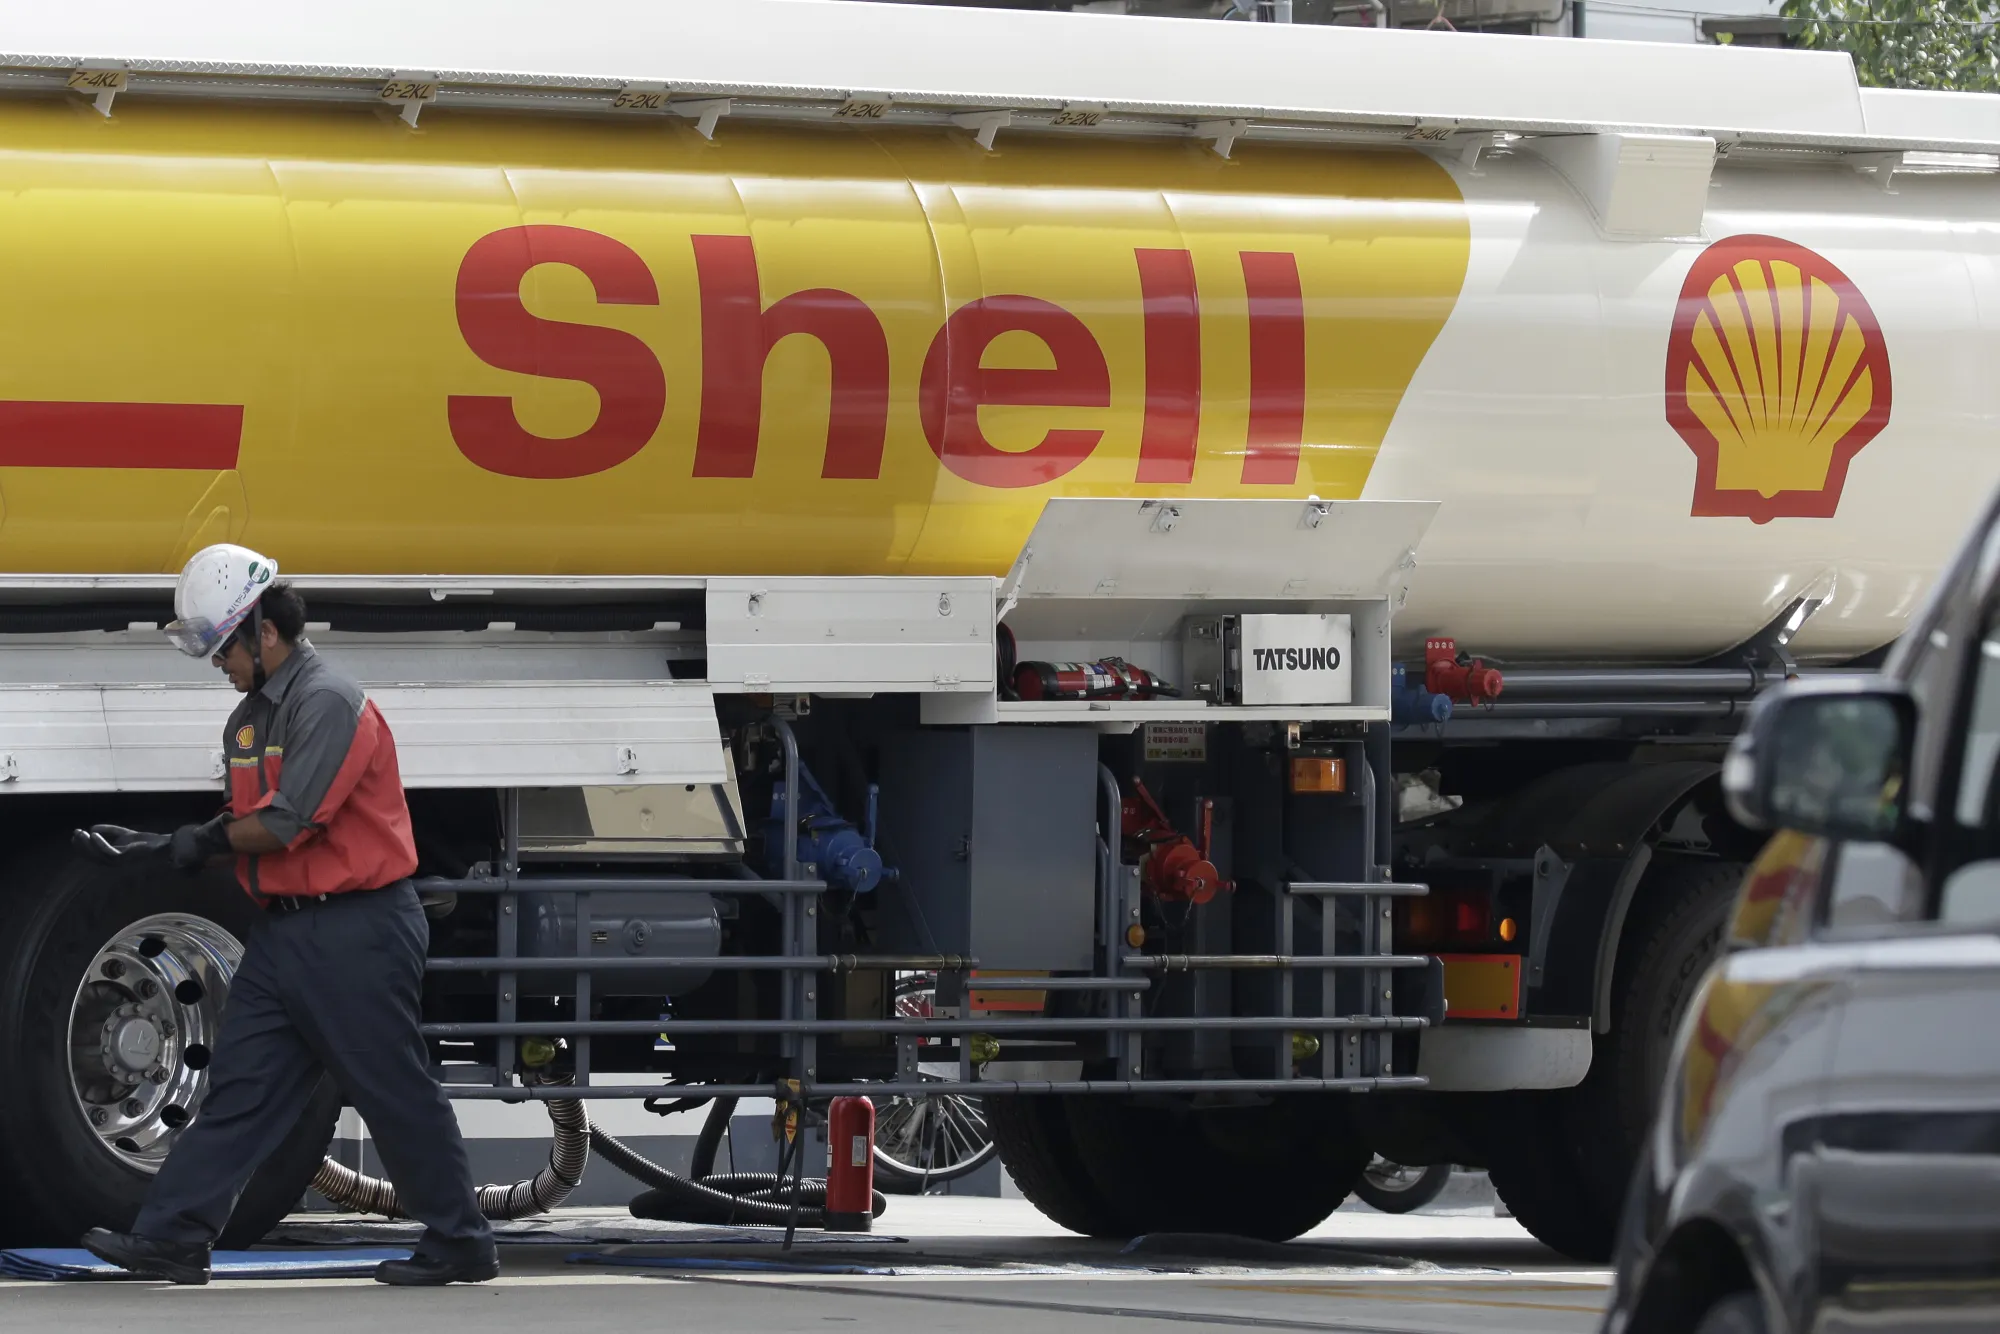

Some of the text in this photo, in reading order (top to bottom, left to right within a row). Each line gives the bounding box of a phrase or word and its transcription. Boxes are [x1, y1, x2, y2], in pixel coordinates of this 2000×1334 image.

[68, 71, 119, 87] 7-4KL
[381, 83, 430, 99] 6-2KL
[613, 93, 661, 109] 5-2KL
[836, 103, 884, 118] 4-2KL
[1053, 112, 1100, 126] 3-2KL
[447, 224, 1306, 488] Shell
[1252, 647, 1341, 671] TATSUNO
